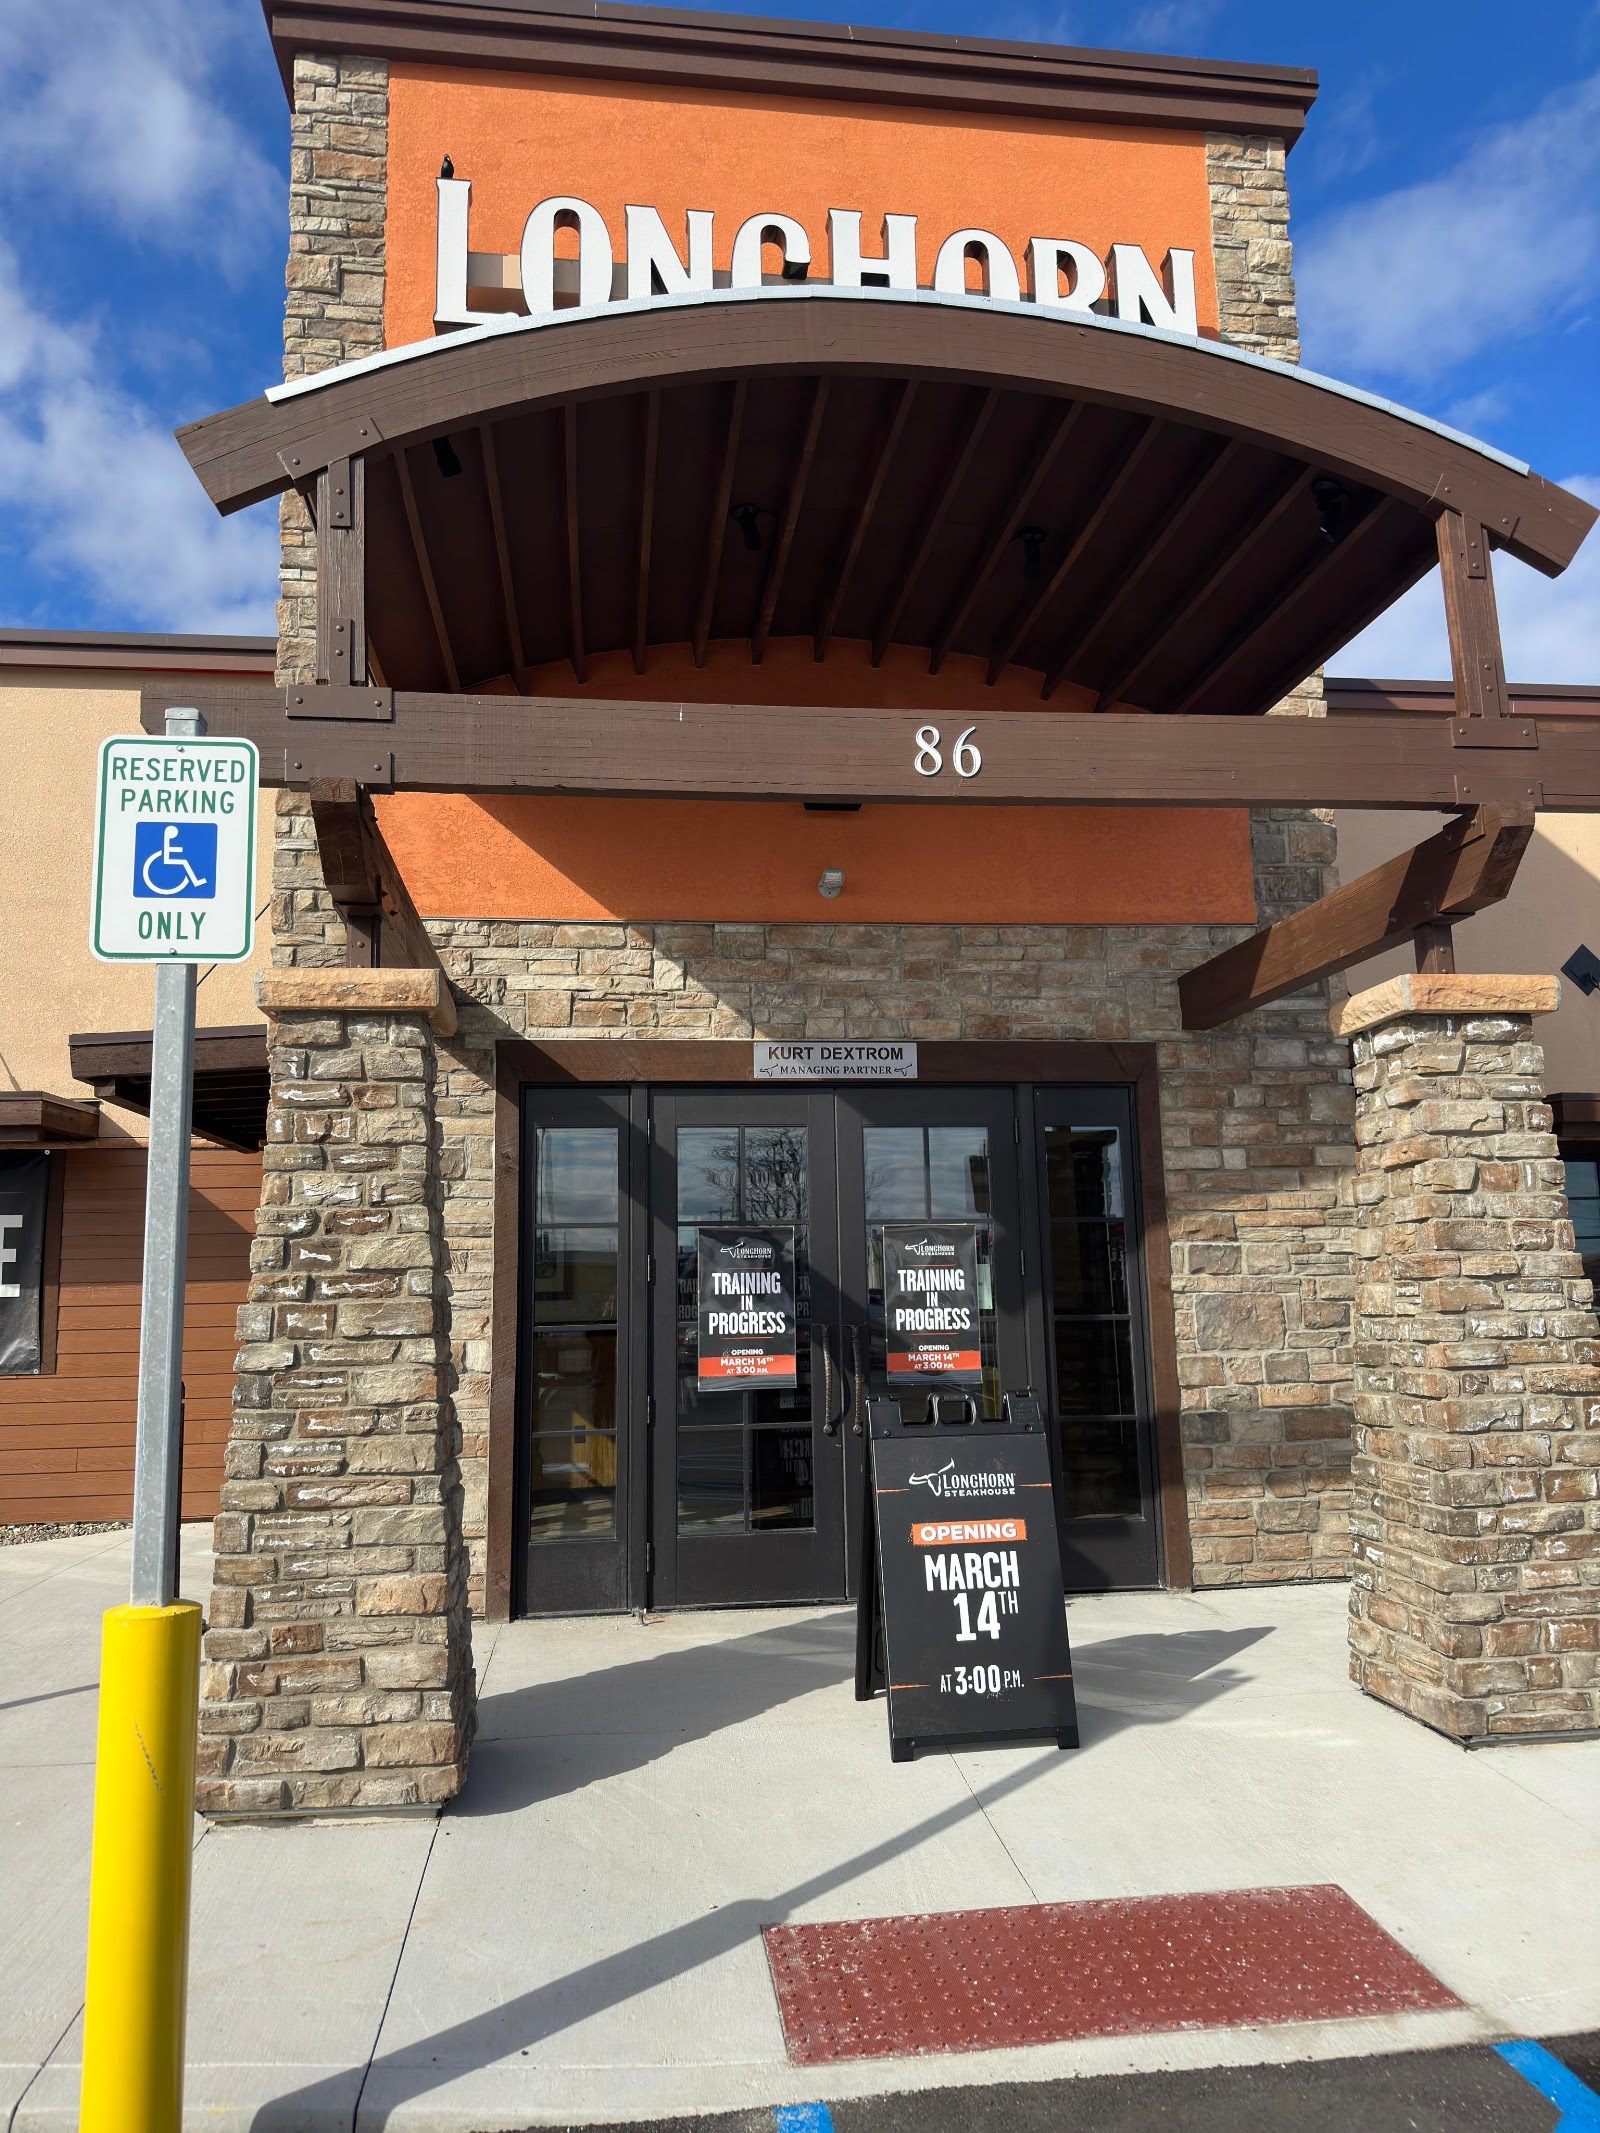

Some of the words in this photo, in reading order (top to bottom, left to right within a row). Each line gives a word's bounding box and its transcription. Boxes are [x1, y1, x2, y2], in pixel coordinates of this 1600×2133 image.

[434, 178, 1198, 334] LONGHORN
[914, 725, 982, 778] 86
[112, 757, 245, 783] RESERVED
[121, 788, 235, 814] PARKING
[138, 911, 207, 940] ONLY
[768, 1046, 814, 1060] KURT
[820, 1046, 904, 1061] DEXTROM
[780, 1065, 840, 1075] MANAGING
[843, 1065, 893, 1075] PARTNER
[736, 1247, 772, 1255] LONGHORN
[921, 1244, 955, 1253] LONGHORN
[712, 1271, 781, 1295] TRAINING
[897, 1268, 965, 1292] TRAINING
[741, 1294, 753, 1311] IN
[926, 1291, 938, 1307] IN
[708, 1311, 786, 1335] PROGRESS
[895, 1307, 971, 1331] PROGRESS
[720, 1357, 755, 1366] MARCH
[757, 1356, 774, 1366] 14TH
[731, 1348, 764, 1356] OPENING
[908, 1352, 942, 1362] MARCH
[943, 1352, 960, 1361] 14TH
[736, 1366, 756, 1374] 3:00
[923, 1361, 942, 1370] 3:00
[943, 1472, 1015, 1490] LONGHORN
[944, 1487, 1016, 1497] STEAKHOUSE
[920, 1522, 1017, 1542] OPENING
[924, 1550, 1020, 1592] MARCH
[953, 1590, 1019, 1642] 14TH
[940, 1674, 952, 1693] AT
[954, 1664, 1001, 1695] 3:00
[1003, 1669, 1025, 1689] P.M.
